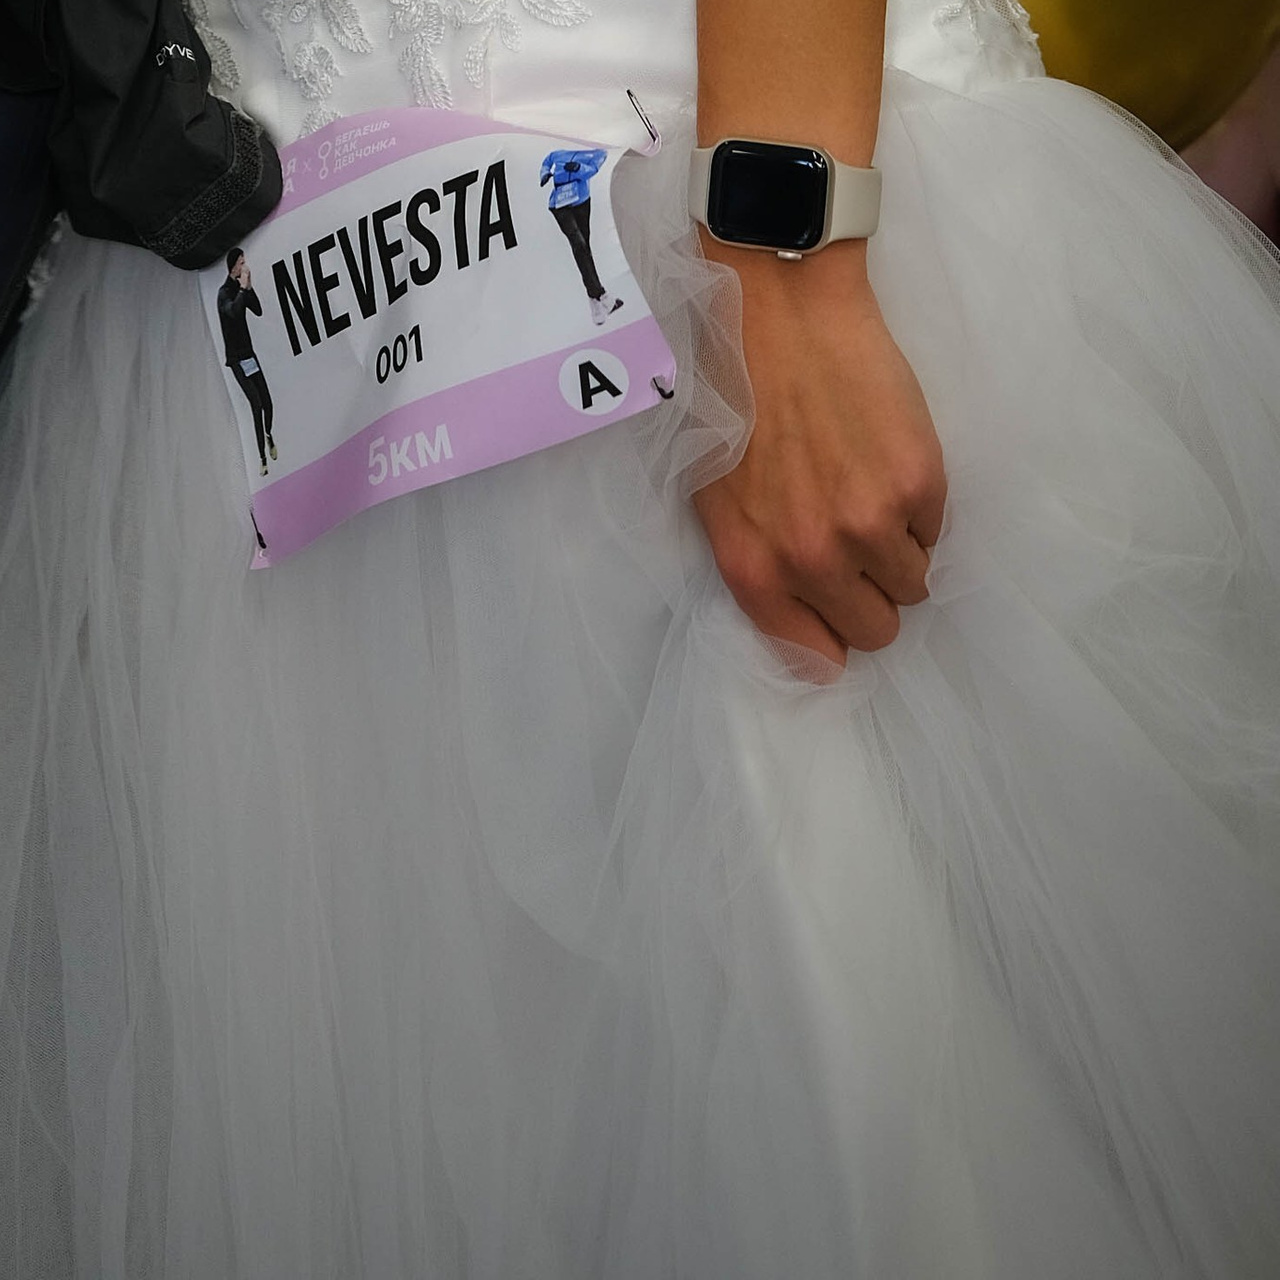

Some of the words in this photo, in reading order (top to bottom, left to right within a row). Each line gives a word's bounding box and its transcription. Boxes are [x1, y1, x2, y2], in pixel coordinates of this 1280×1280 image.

[333, 120, 391, 148] БЕГАЕШЬ
[333, 139, 358, 158] КАК
[271, 159, 518, 357] NEVESTA
[375, 323, 425, 385] 001
[576, 359, 624, 410] A
